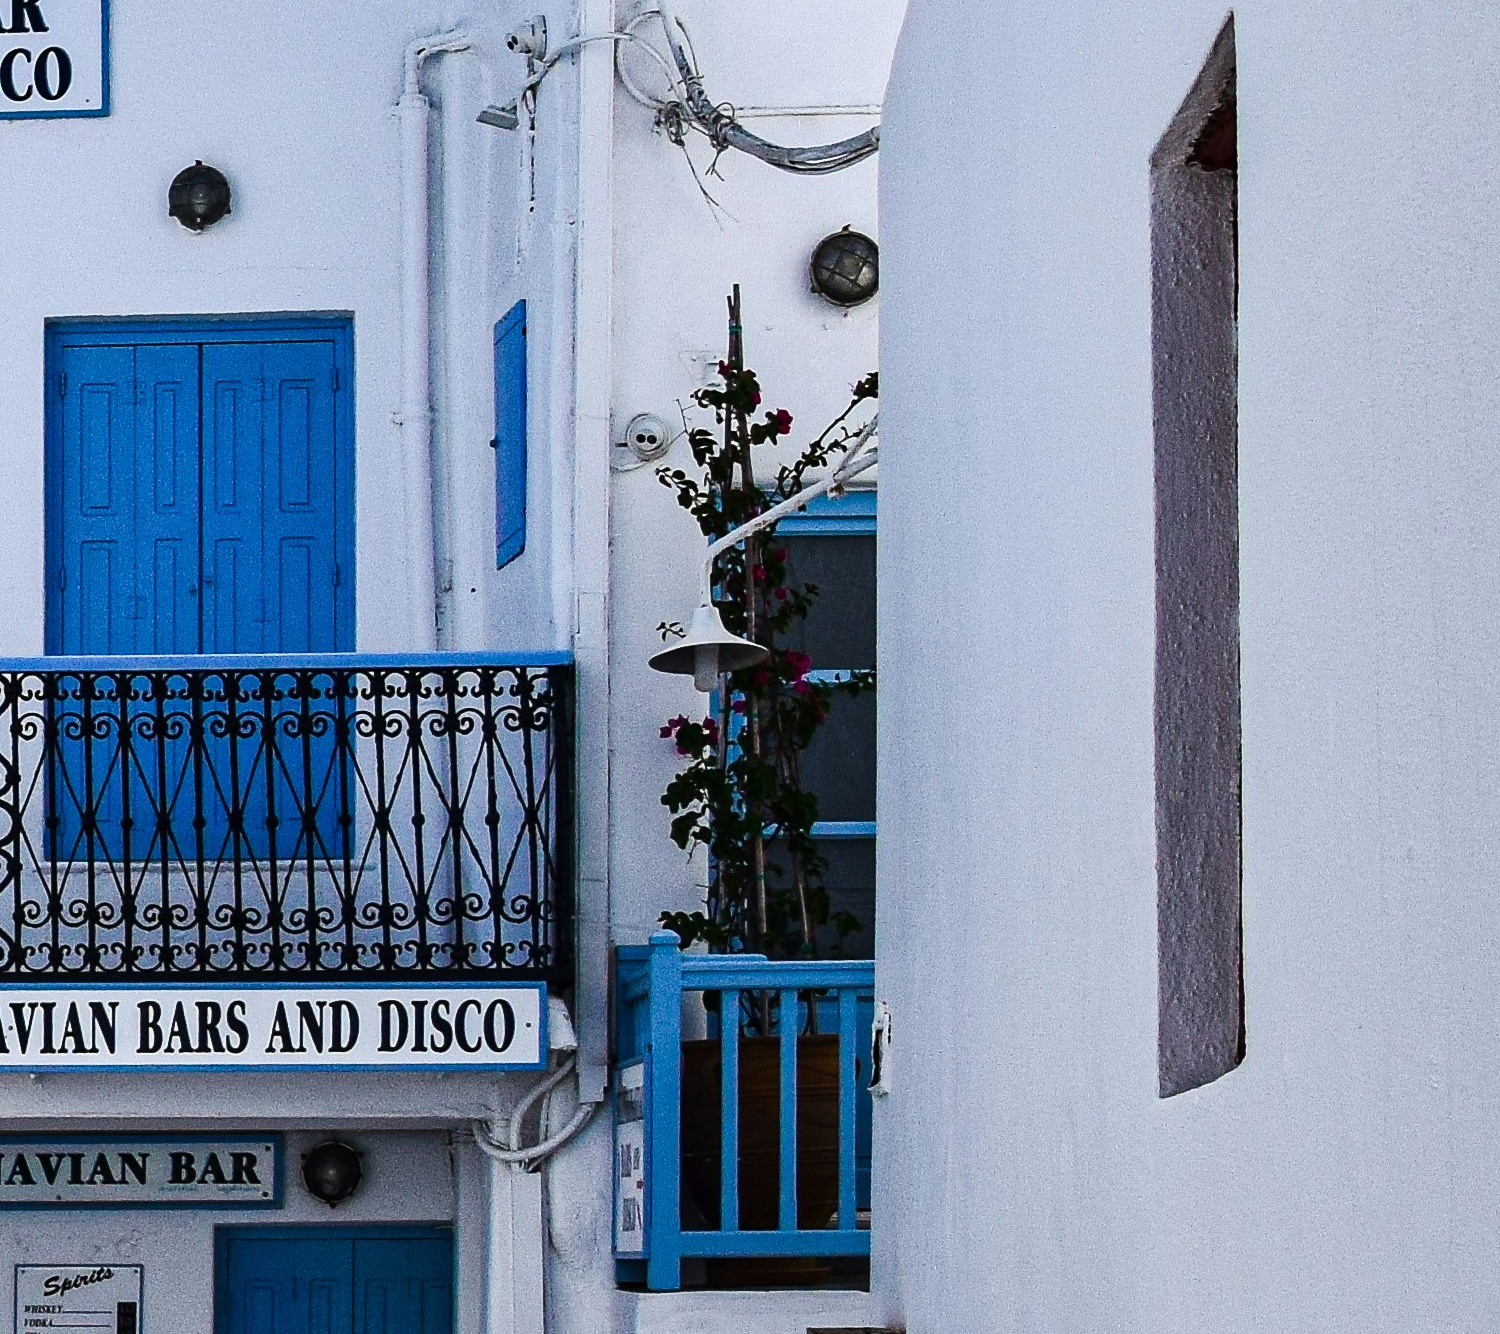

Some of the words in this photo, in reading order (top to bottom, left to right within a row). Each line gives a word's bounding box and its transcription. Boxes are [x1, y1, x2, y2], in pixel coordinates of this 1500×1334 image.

[135, 998, 251, 1057] BARS
[266, 997, 360, 1056] AND
[377, 997, 516, 1057] DISCO
[168, 1151, 262, 1185] BAR
[43, 1267, 115, 1297] Spirits
[23, 1319, 53, 1327] VODKA
[24, 1305, 63, 1314] WHISKEY
